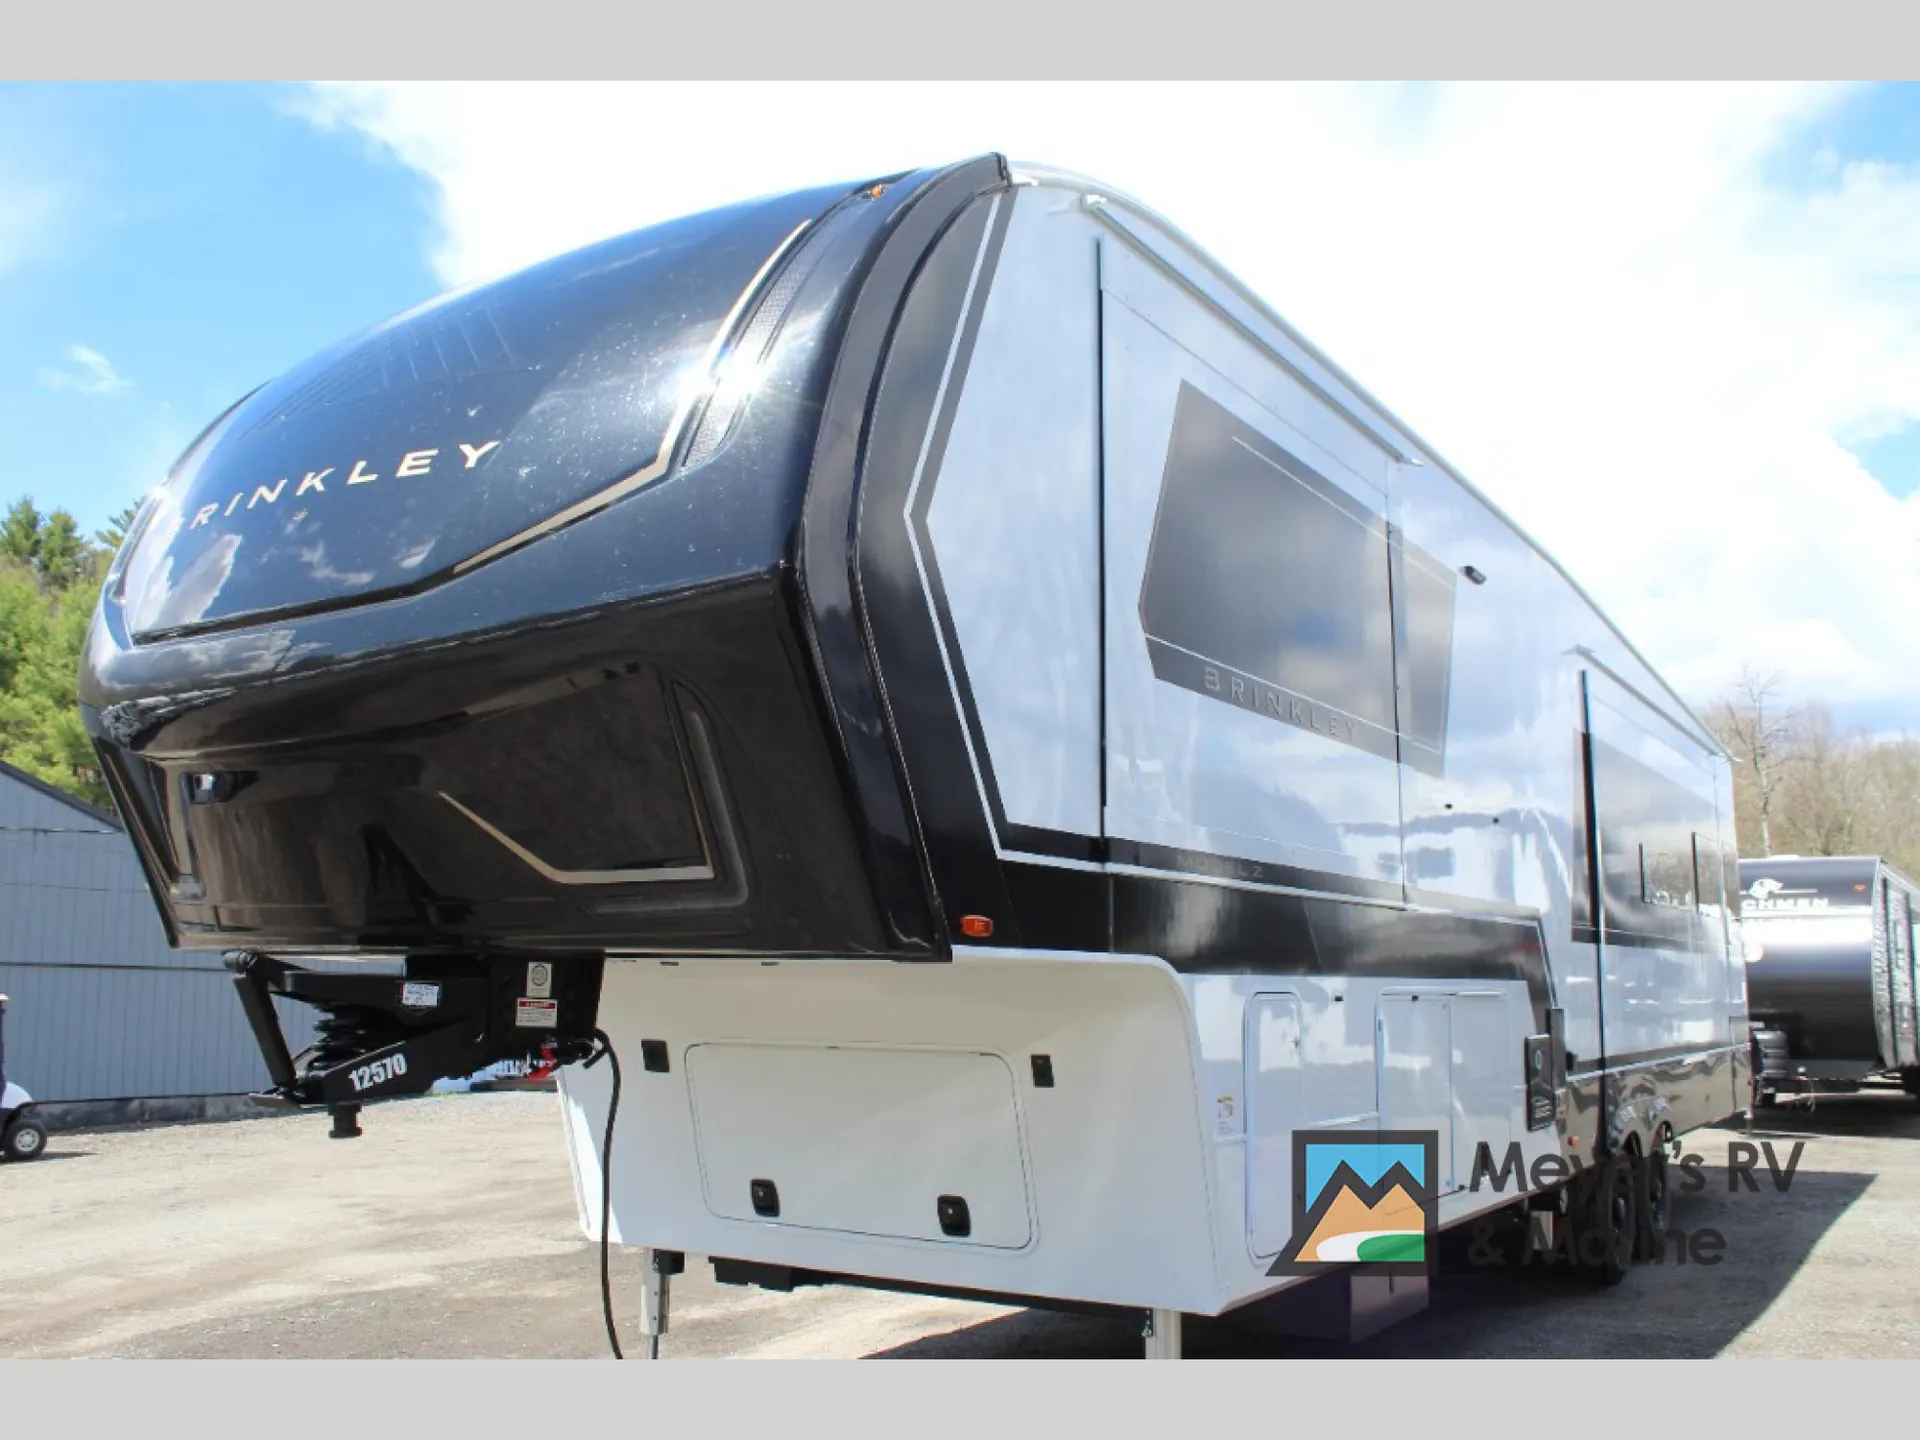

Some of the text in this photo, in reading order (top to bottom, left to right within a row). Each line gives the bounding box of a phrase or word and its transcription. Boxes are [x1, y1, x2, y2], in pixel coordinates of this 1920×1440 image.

[1204, 666, 1358, 740] BRINKLEY
[1252, 865, 1264, 878] Z
[348, 1053, 408, 1092] 12570
